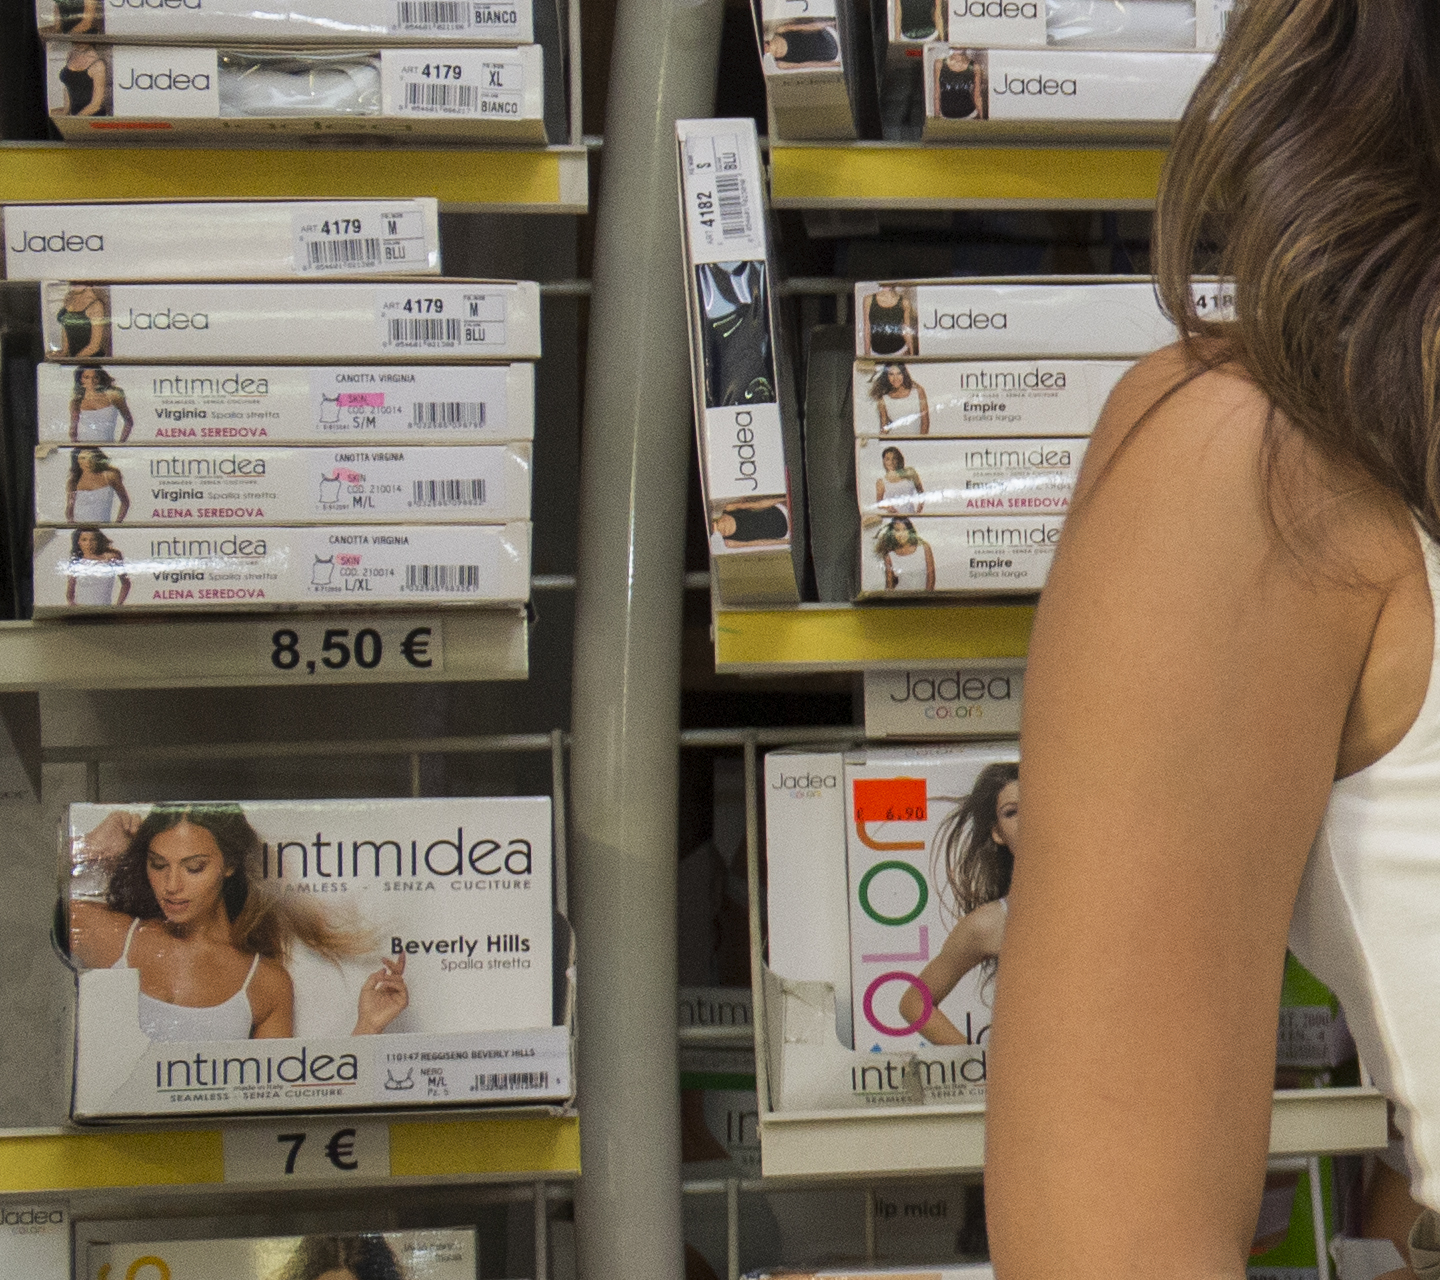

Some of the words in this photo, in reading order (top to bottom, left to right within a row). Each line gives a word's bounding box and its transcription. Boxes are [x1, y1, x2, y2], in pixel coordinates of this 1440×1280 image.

[475, 10, 517, 24] BIANCO
[421, 63, 462, 79] 4179
[118, 68, 210, 91] Jadea
[993, 73, 1077, 96] Jadea
[481, 101, 518, 114] BIANCO
[697, 191, 715, 227] 4182
[320, 219, 361, 235] 4179
[11, 230, 104, 253] Jadea
[385, 247, 405, 260] BLU
[403, 298, 444, 314] 4179
[117, 308, 209, 331] Jadea
[924, 310, 1008, 331] Jadea
[465, 328, 485, 341] BLU
[153, 373, 268, 394] intimidea
[336, 374, 376, 384] CANOTTA
[960, 368, 1067, 389] intimidea
[155, 408, 207, 421] Virginia
[963, 402, 1006, 412] Empire
[352, 417, 376, 429] S/M
[155, 427, 197, 437] ALENA
[201, 427, 268, 437] SEREDOVA
[335, 453, 369, 462] CANOTTA
[735, 412, 758, 491] Jadea
[965, 447, 1071, 468] intimidea
[150, 454, 266, 475] intimidea
[151, 489, 204, 502] Virginia
[352, 496, 375, 509] M/L
[966, 499, 1004, 508] ALENA
[152, 508, 193, 518] ALENA
[197, 508, 264, 518] SEREDOVA
[151, 535, 267, 556] intimidea
[329, 535, 369, 545] CANOTTA
[969, 558, 1013, 569] Empire
[152, 571, 205, 583] Virginia
[345, 579, 373, 592] L/XL
[153, 589, 194, 599] ALENA
[198, 589, 265, 599] SEREDOVA
[270, 628, 383, 675] 8,50
[401, 628, 433, 668] €
[891, 672, 1012, 704] Jadea
[772, 772, 837, 791] Jadea
[886, 805, 926, 821] 6.90
[261, 827, 533, 878] intimidea
[383, 881, 436, 892] SENZA
[450, 879, 532, 891] CUCITURE
[391, 935, 478, 957] Beverly
[486, 932, 531, 954] Hills
[440, 956, 484, 971] Spalla
[488, 956, 532, 971] stretta
[156, 1046, 359, 1088] intimidea
[277, 1134, 306, 1175] 7
[325, 1128, 358, 1171] €
